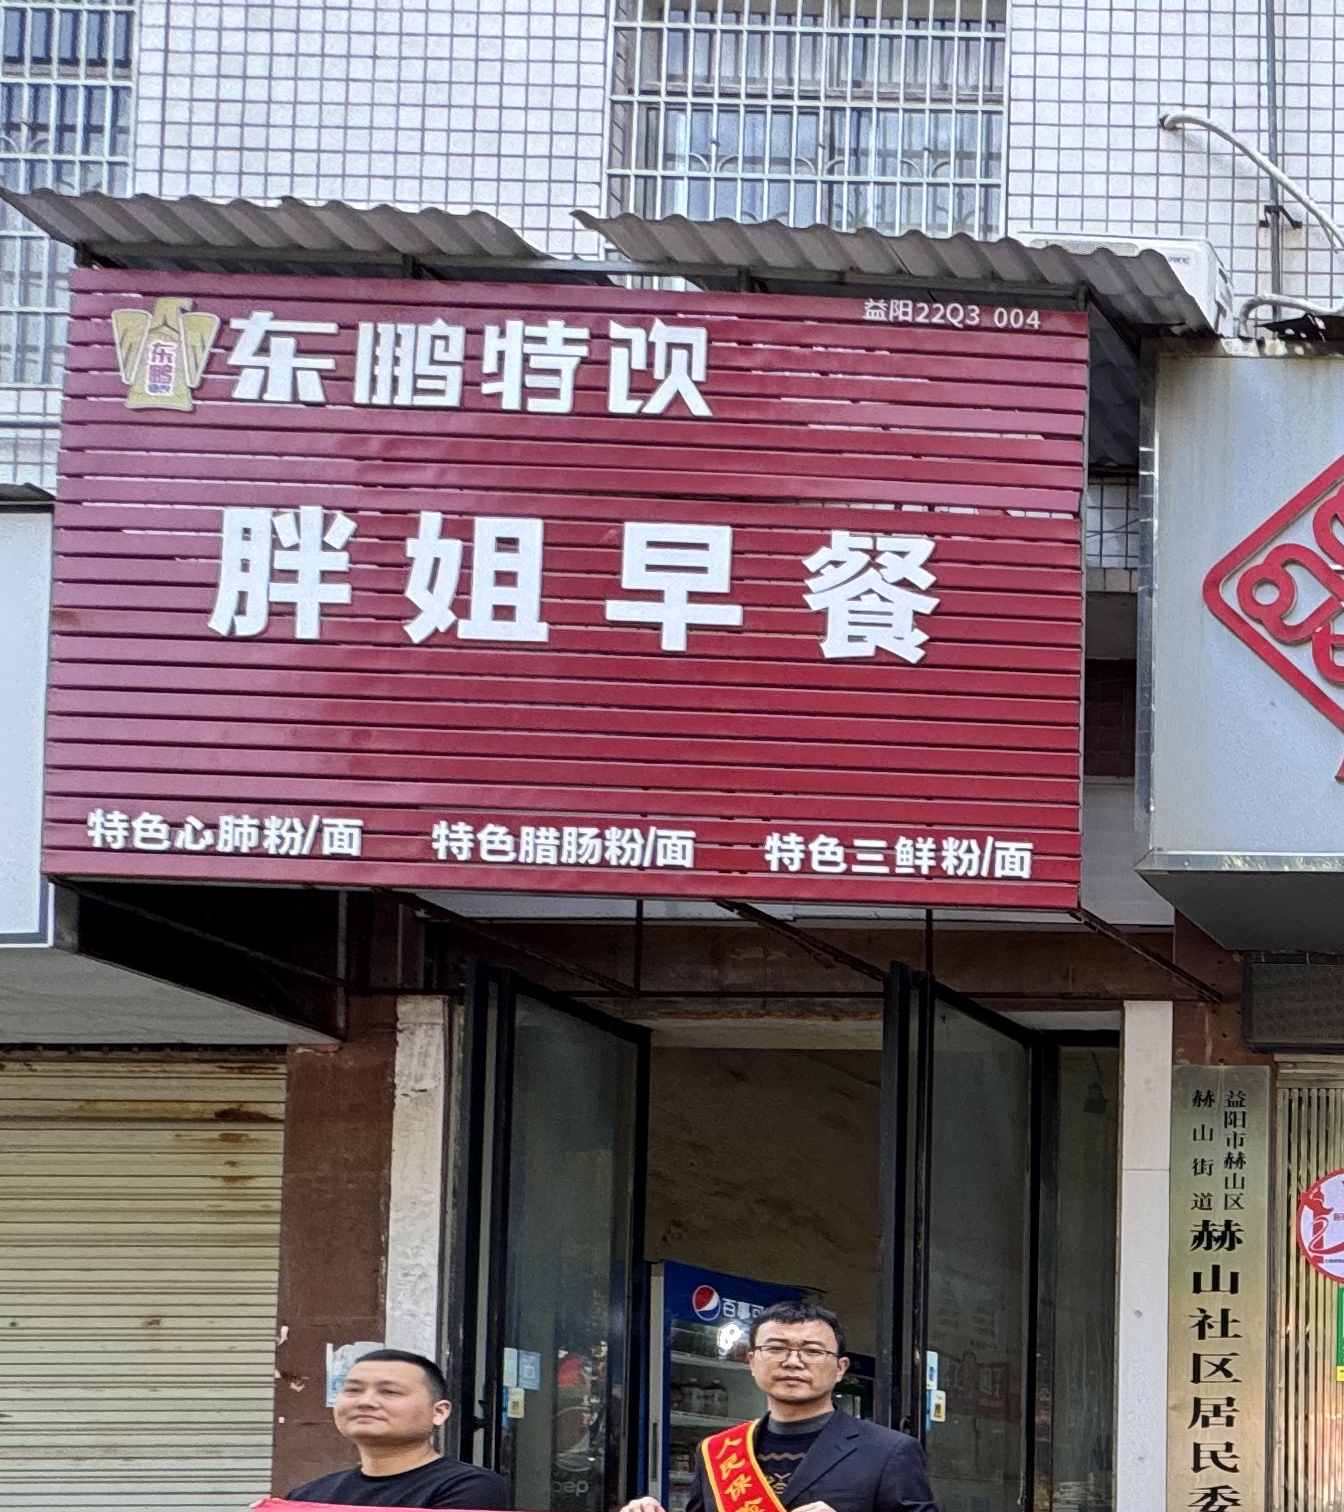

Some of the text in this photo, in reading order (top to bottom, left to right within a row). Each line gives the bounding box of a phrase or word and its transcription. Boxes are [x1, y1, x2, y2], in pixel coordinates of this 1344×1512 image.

[227, 310, 713, 418] 东鹏特饮
[863, 298, 1042, 330] 益阳22Q3 004
[206, 504, 941, 665] 胖姐早餐
[86, 808, 1034, 881] 特色心肺粉/面 特色腊肠粉/面 特色三鲜粉/面
[1190, 1089, 1216, 1211] 赫山街道
[1223, 1090, 1247, 1211] 益阳市赫山区
